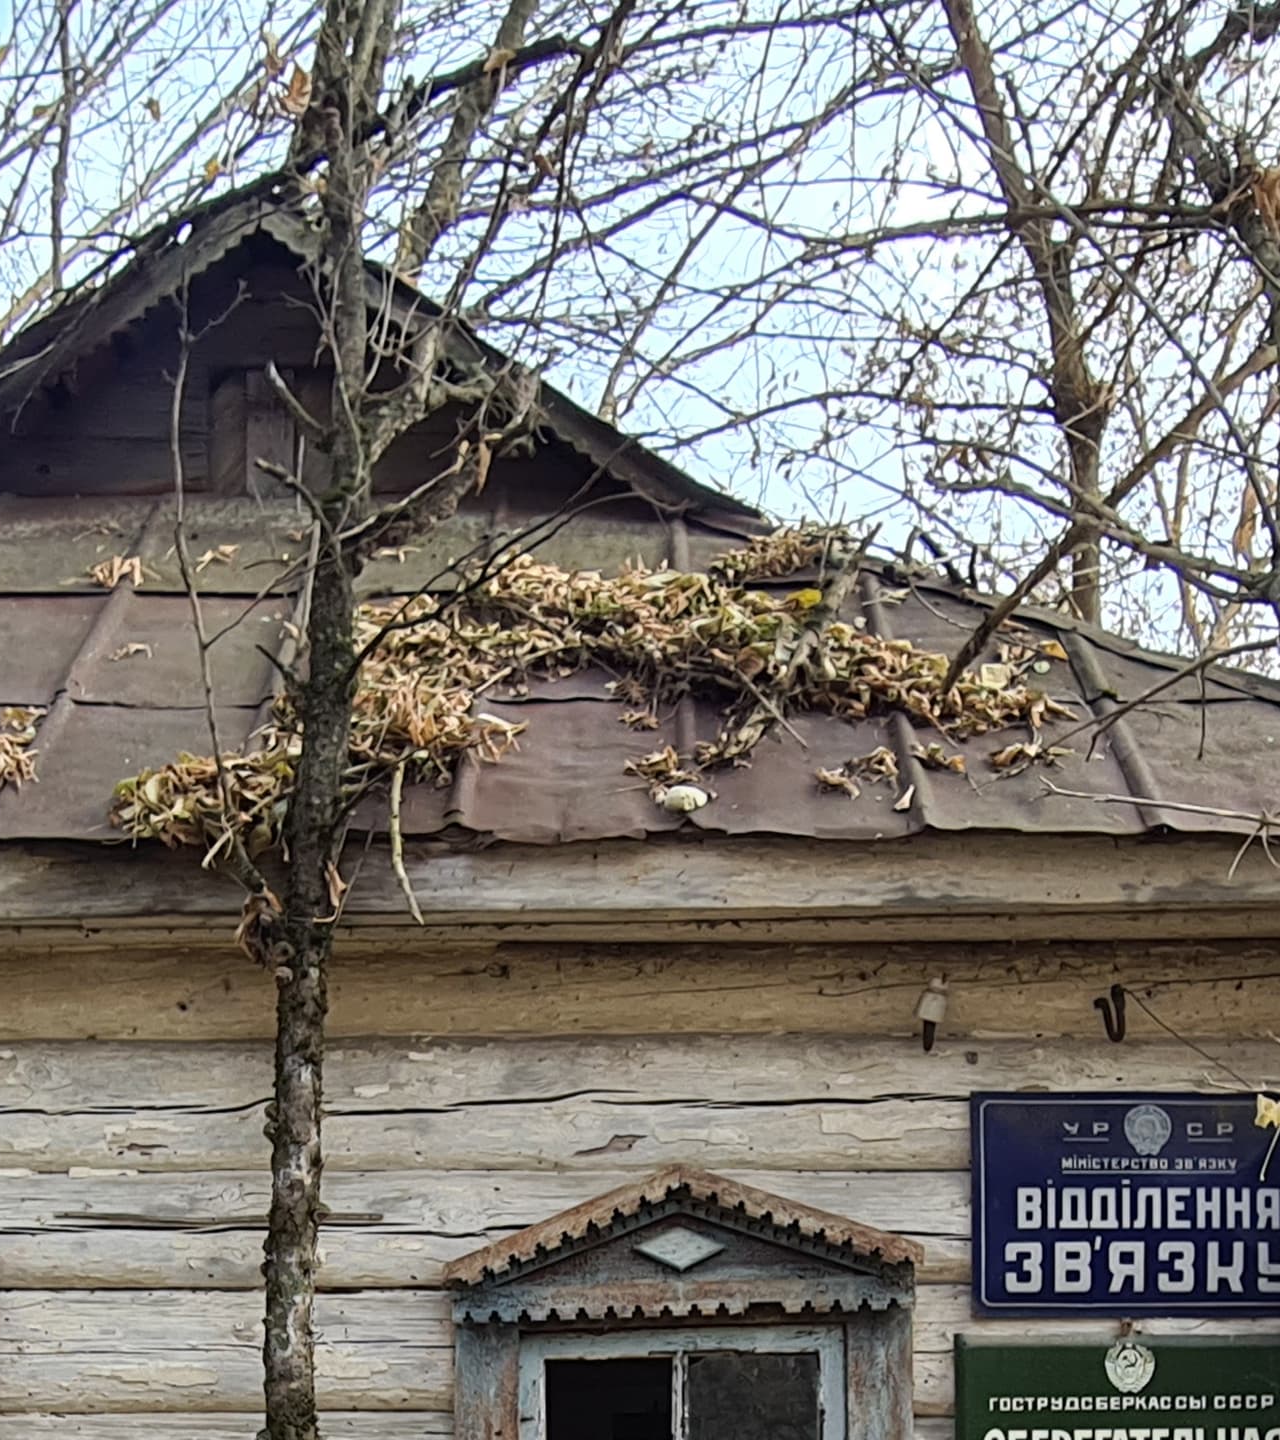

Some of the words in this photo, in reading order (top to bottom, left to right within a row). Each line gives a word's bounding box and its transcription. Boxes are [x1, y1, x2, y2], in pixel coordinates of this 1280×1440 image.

[1017, 1180, 1280, 1229] ВІДДІЛЕННЯ
[989, 1395, 1207, 1411] ГОСТРУДСБЕРКАССЫ
[1214, 1394, 1275, 1410] СССР
